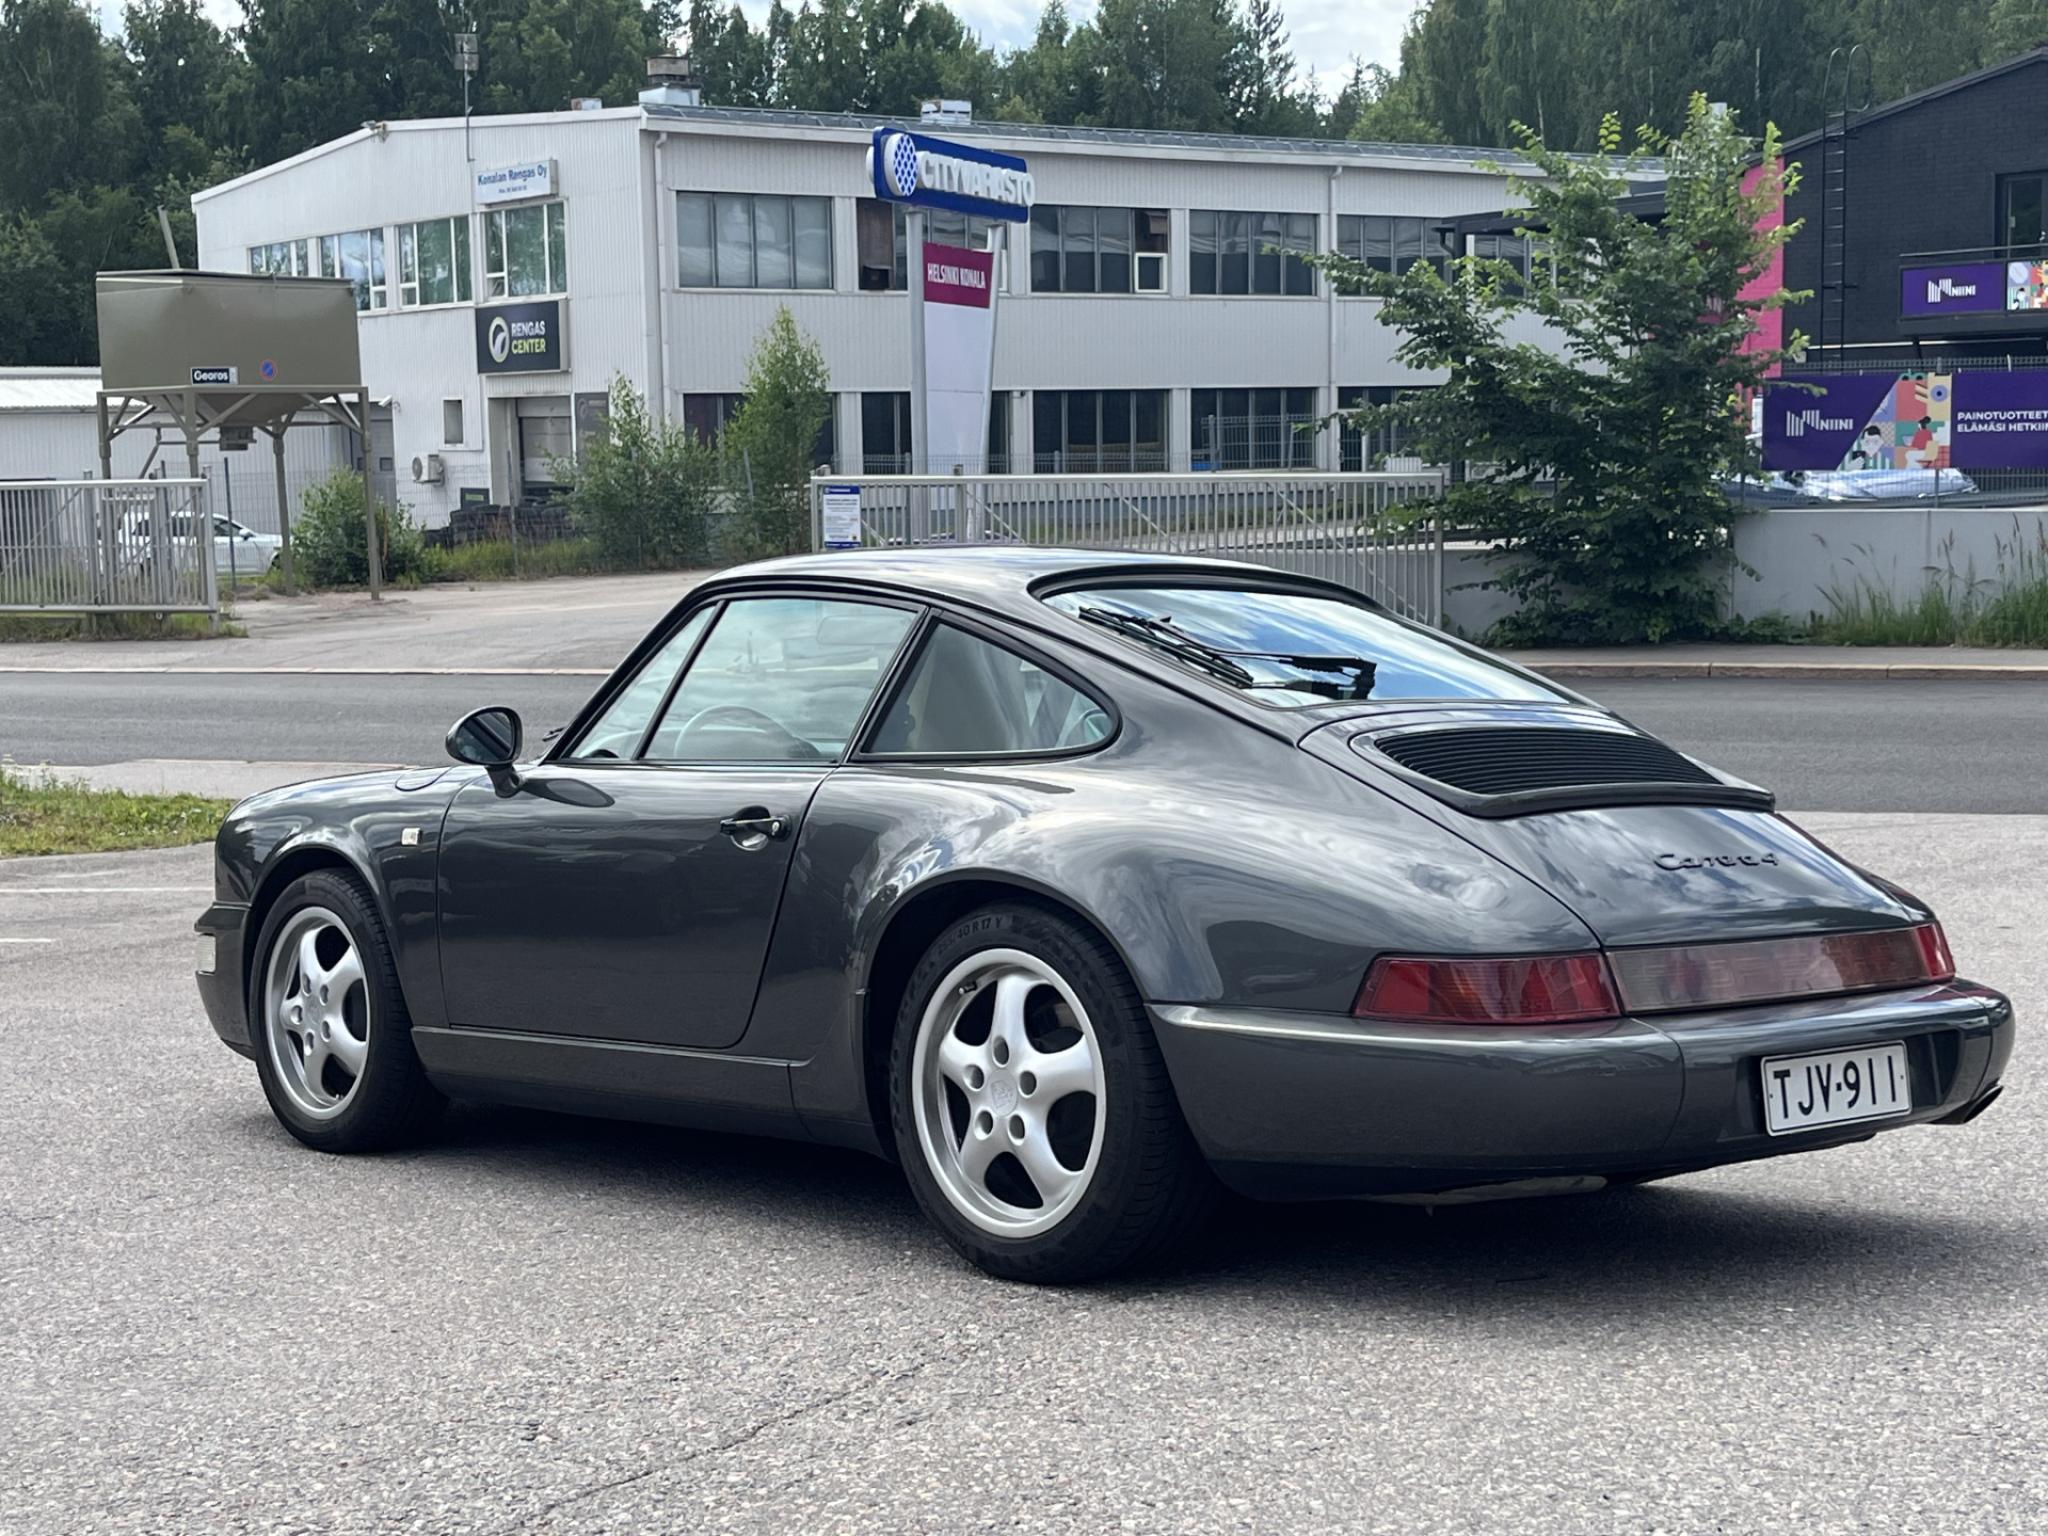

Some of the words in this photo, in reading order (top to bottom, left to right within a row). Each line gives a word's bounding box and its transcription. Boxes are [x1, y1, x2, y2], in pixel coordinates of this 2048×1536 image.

[478, 171, 507, 185] Konalan
[508, 168, 535, 182] Rengas
[536, 164, 547, 178] Oy
[916, 151, 1036, 206] CITYVARASTO
[927, 263, 959, 286] HELSINKI
[960, 267, 986, 289] KONALA
[512, 321, 546, 337] RENGAS
[511, 338, 546, 354] CENTER
[1957, 410, 2048, 420] PAINOTUOTTEET
[1819, 418, 1853, 431] NIINI
[1957, 421, 2006, 432] ELÄMÄSI
[1773, 1055, 1896, 1119] TJV-911
